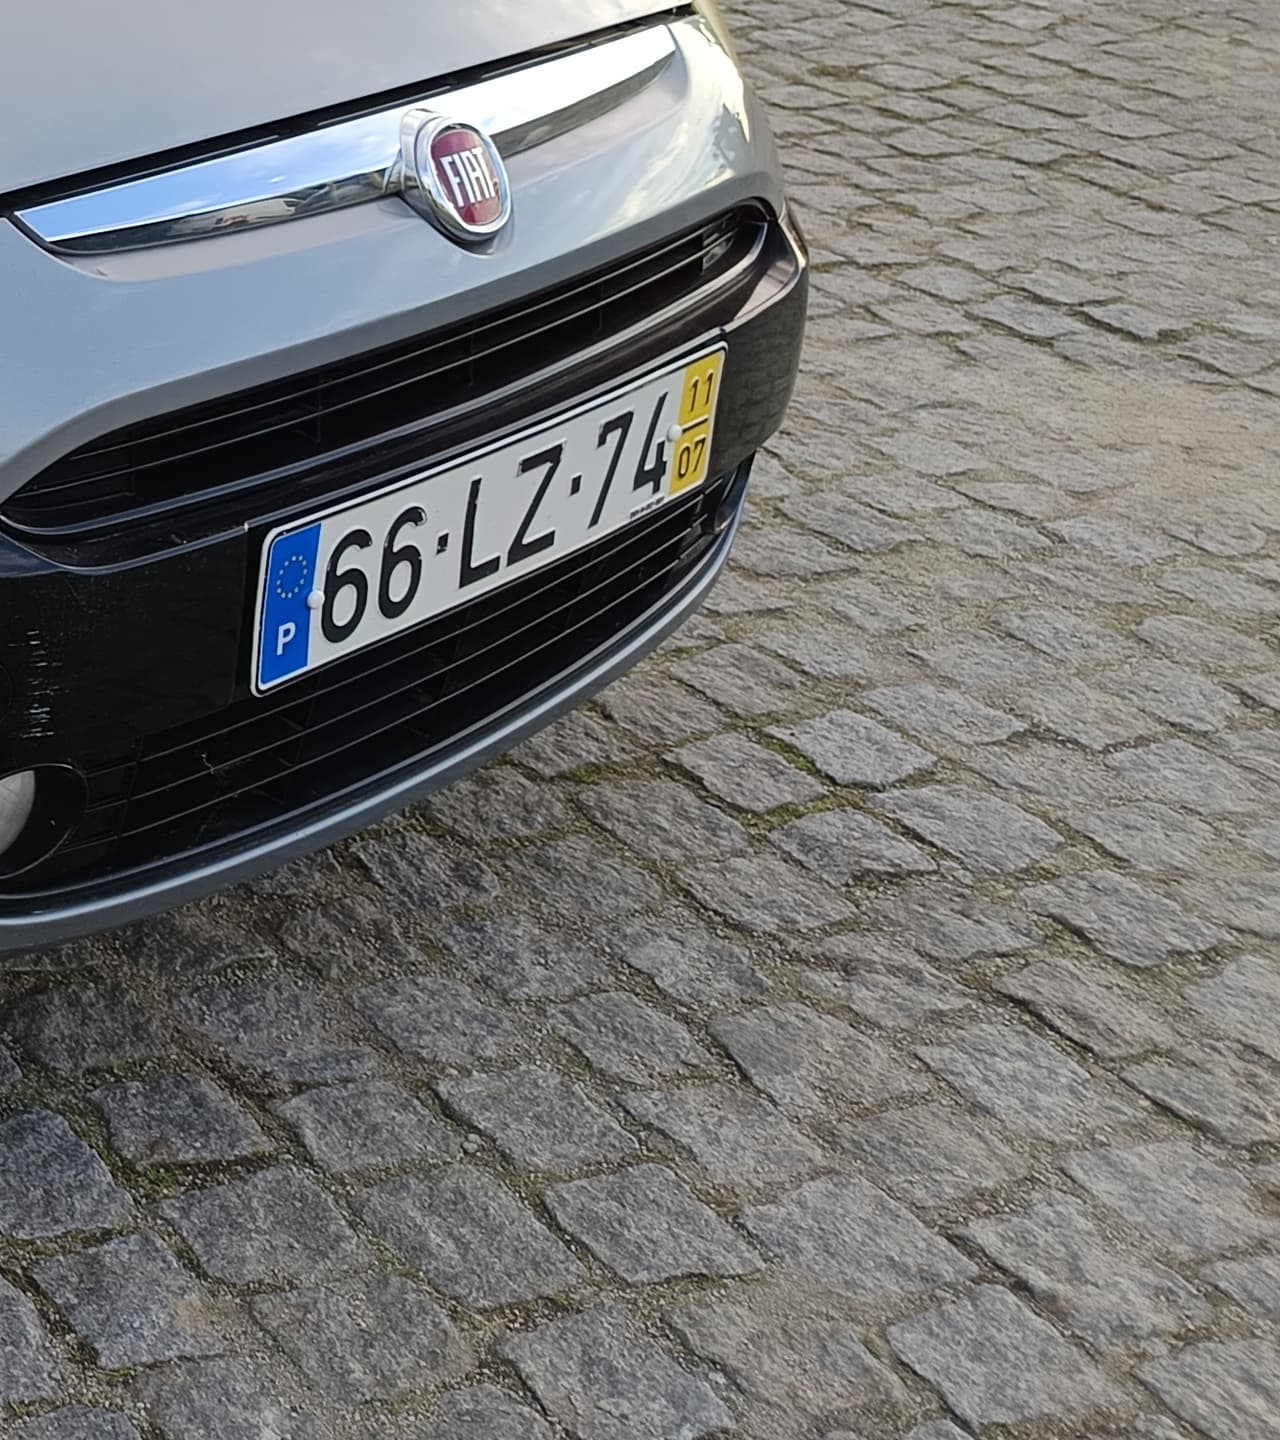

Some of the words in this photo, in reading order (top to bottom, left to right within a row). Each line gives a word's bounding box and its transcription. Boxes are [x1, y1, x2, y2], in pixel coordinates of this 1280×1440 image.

[439, 146, 496, 209] FIAT
[687, 371, 715, 412] 11
[677, 436, 707, 479] 07
[277, 621, 297, 656] P
